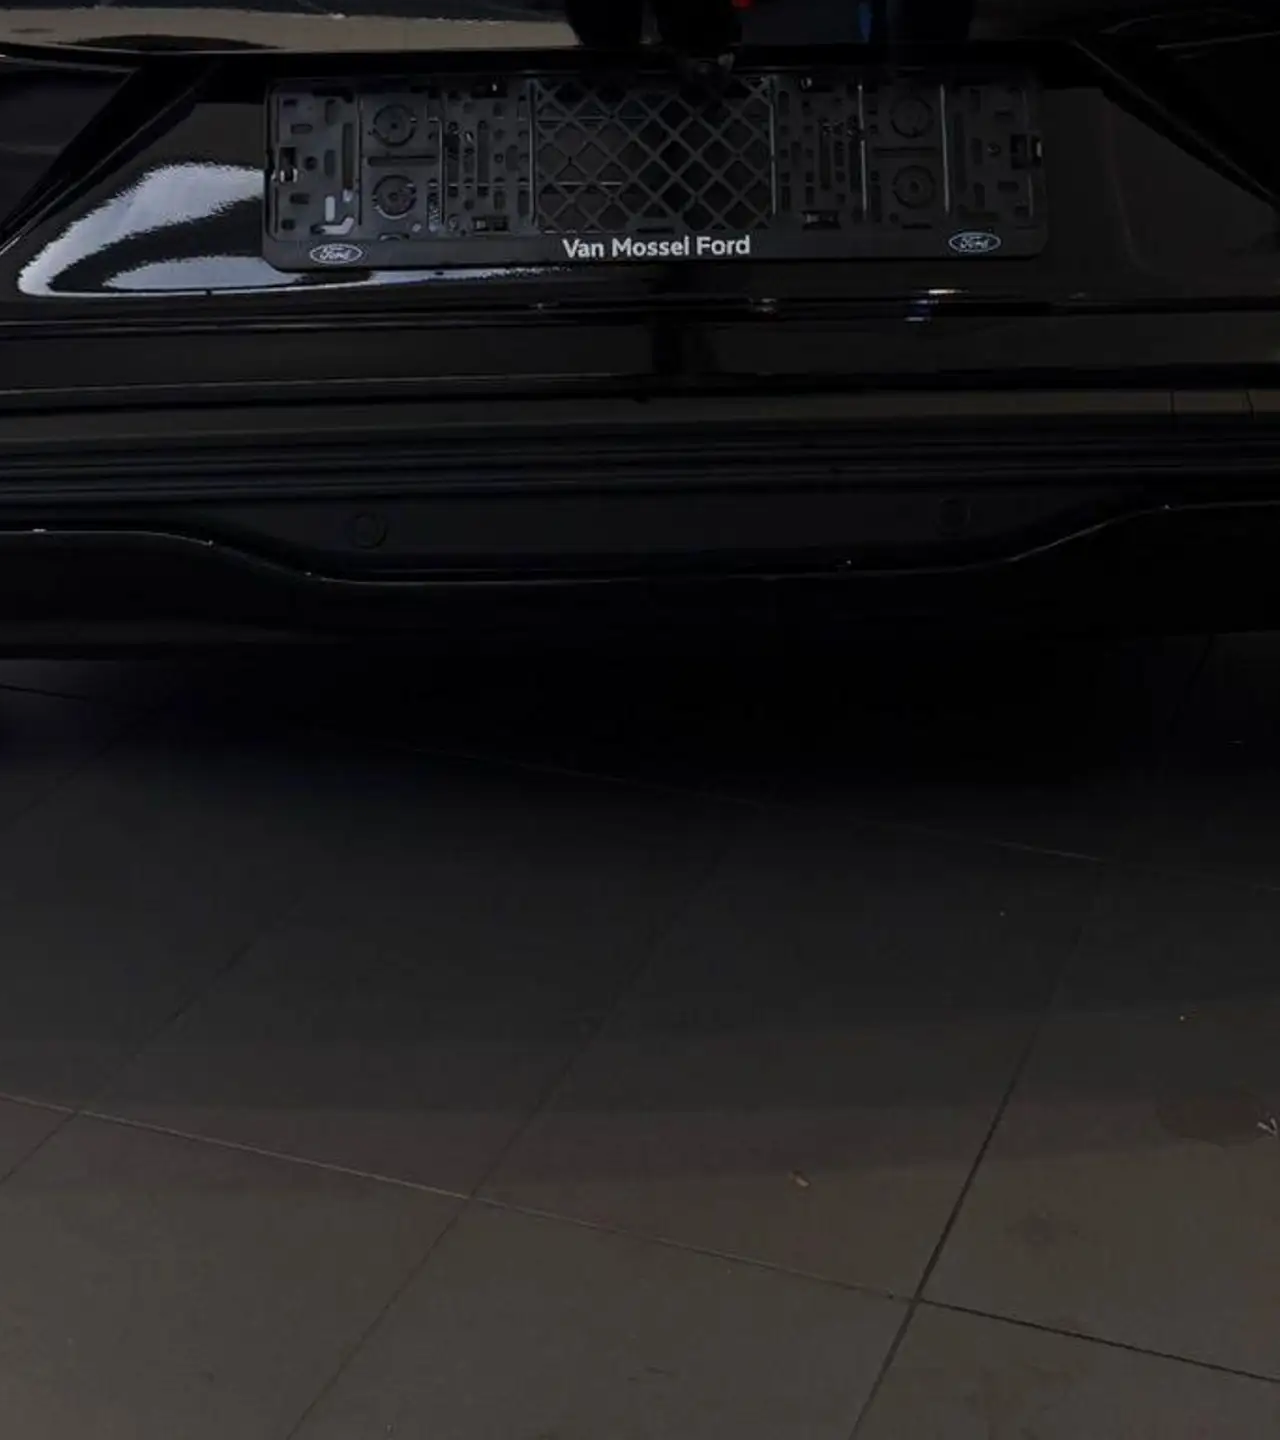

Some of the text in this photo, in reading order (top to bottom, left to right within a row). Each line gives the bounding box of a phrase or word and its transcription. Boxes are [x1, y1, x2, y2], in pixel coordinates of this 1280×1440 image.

[562, 234, 751, 258] Van Mossel Ford
